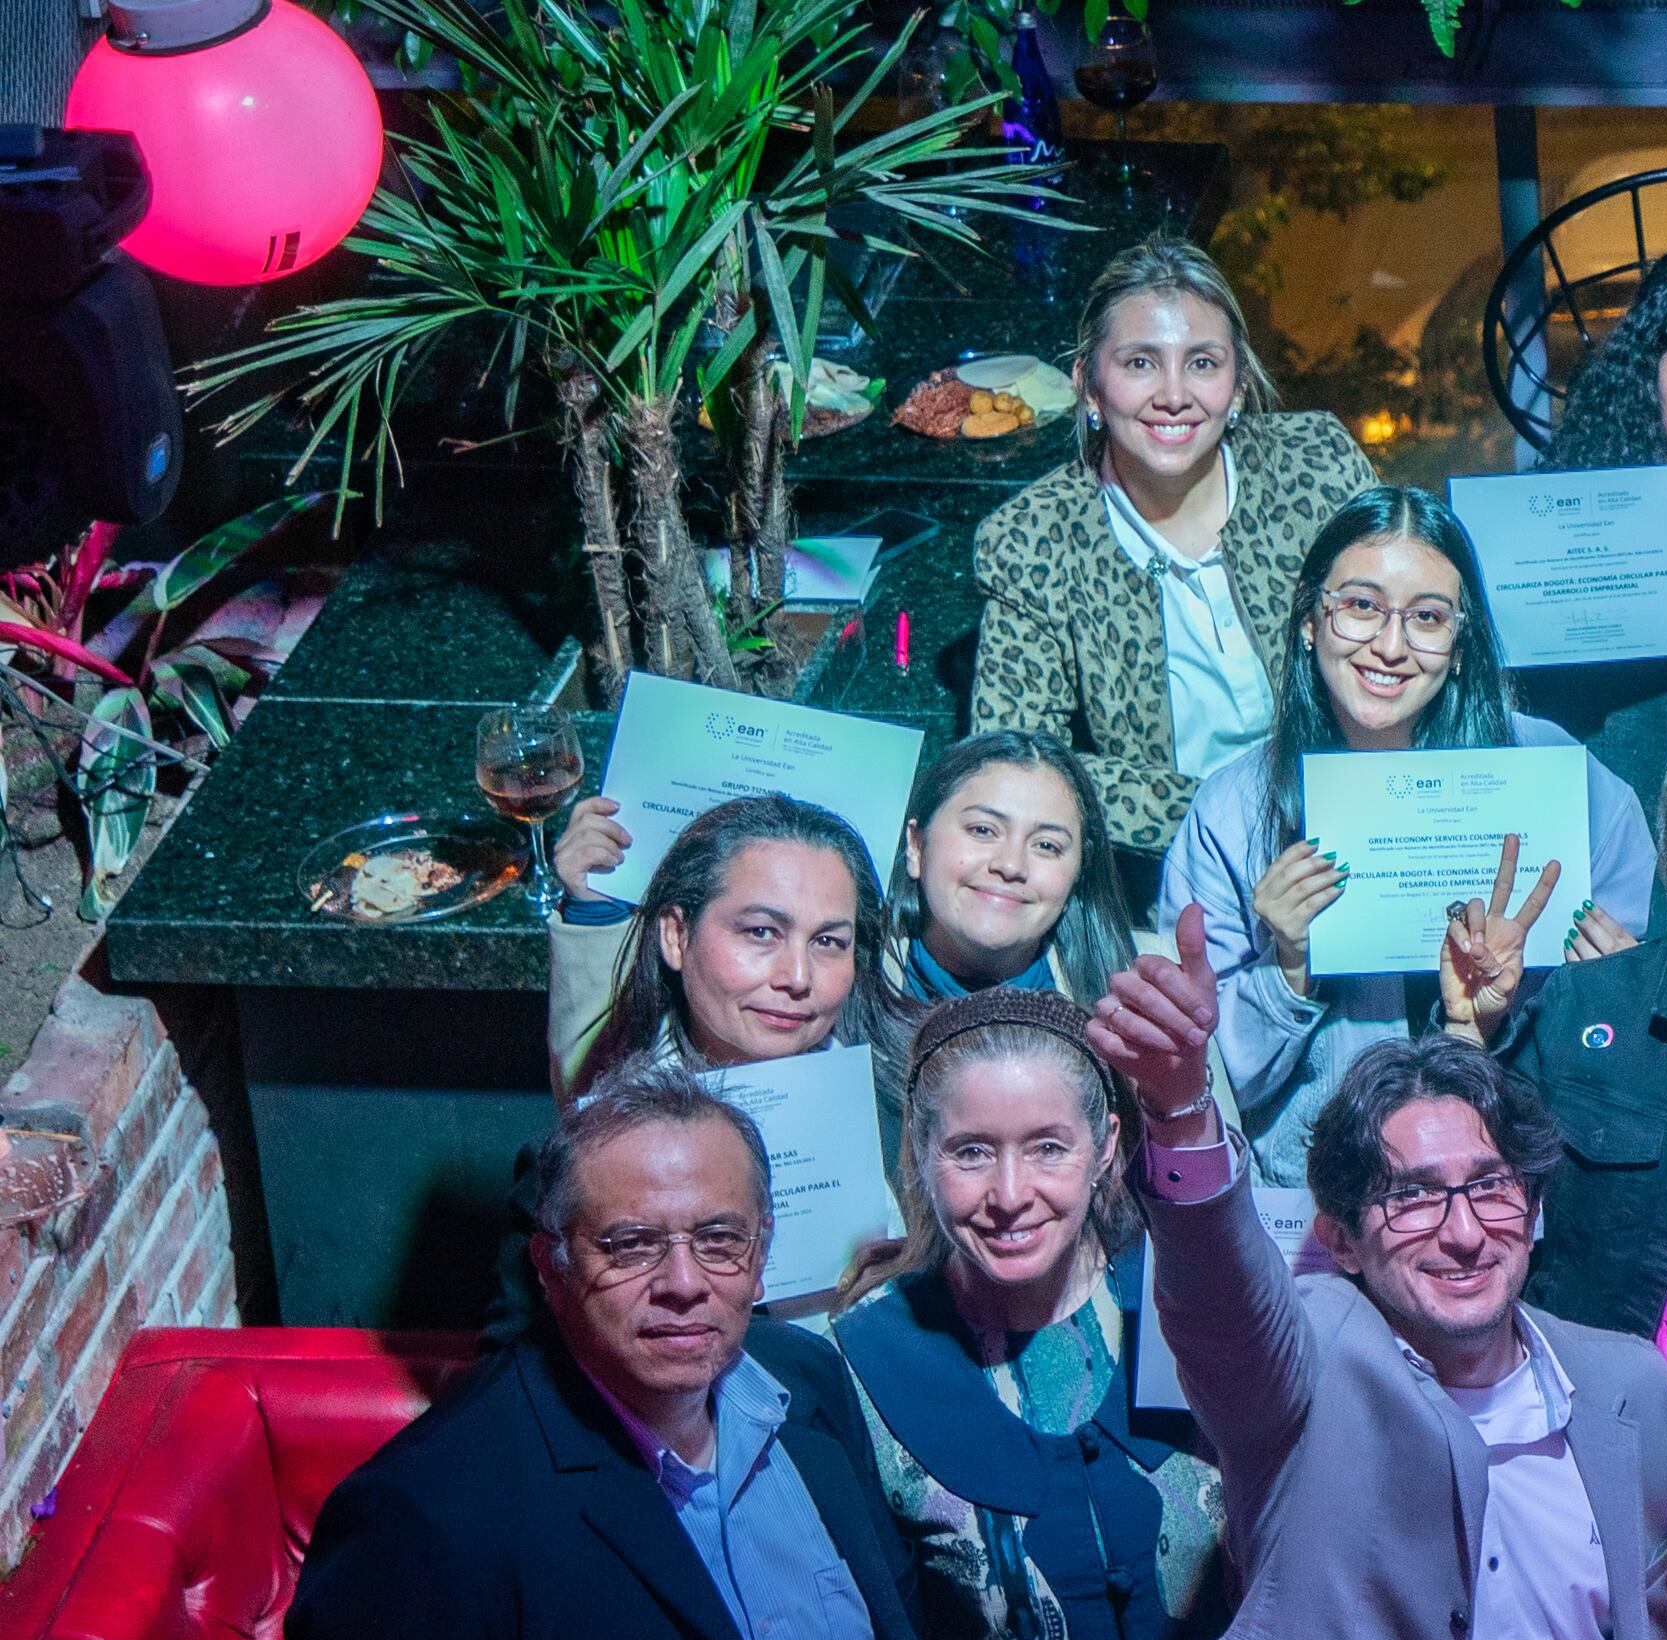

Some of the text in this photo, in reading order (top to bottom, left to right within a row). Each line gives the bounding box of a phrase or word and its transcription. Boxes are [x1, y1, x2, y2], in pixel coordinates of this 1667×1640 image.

[1557, 497, 1581, 507] ean
[1496, 580, 1542, 591] CIRCULARIZA
[1543, 576, 1576, 587] BOGOTÁ:
[1577, 573, 1618, 584] ECONOMÍA
[1619, 571, 1654, 581] CIRCULAR
[1543, 582, 1639, 597] DESARROLLO EMPRESARIAL
[737, 723, 765, 738] ean
[722, 781, 750, 792] GRUPO
[1416, 779, 1442, 788] ean
[642, 801, 695, 817] CIRCULARIZA
[1369, 832, 1505, 845] GREEN ECONOMY SERVICES COLOMBI
[1349, 865, 1542, 879] CIRCULARIZA BOGOTÁ: ECONOMÍA PARA
[1399, 878, 1497, 888] DESARROLLO EMPRESARI
[771, 1186, 806, 1198] IRCULAR
[808, 1182, 830, 1191] PARA
[1274, 1218, 1303, 1229] ean
